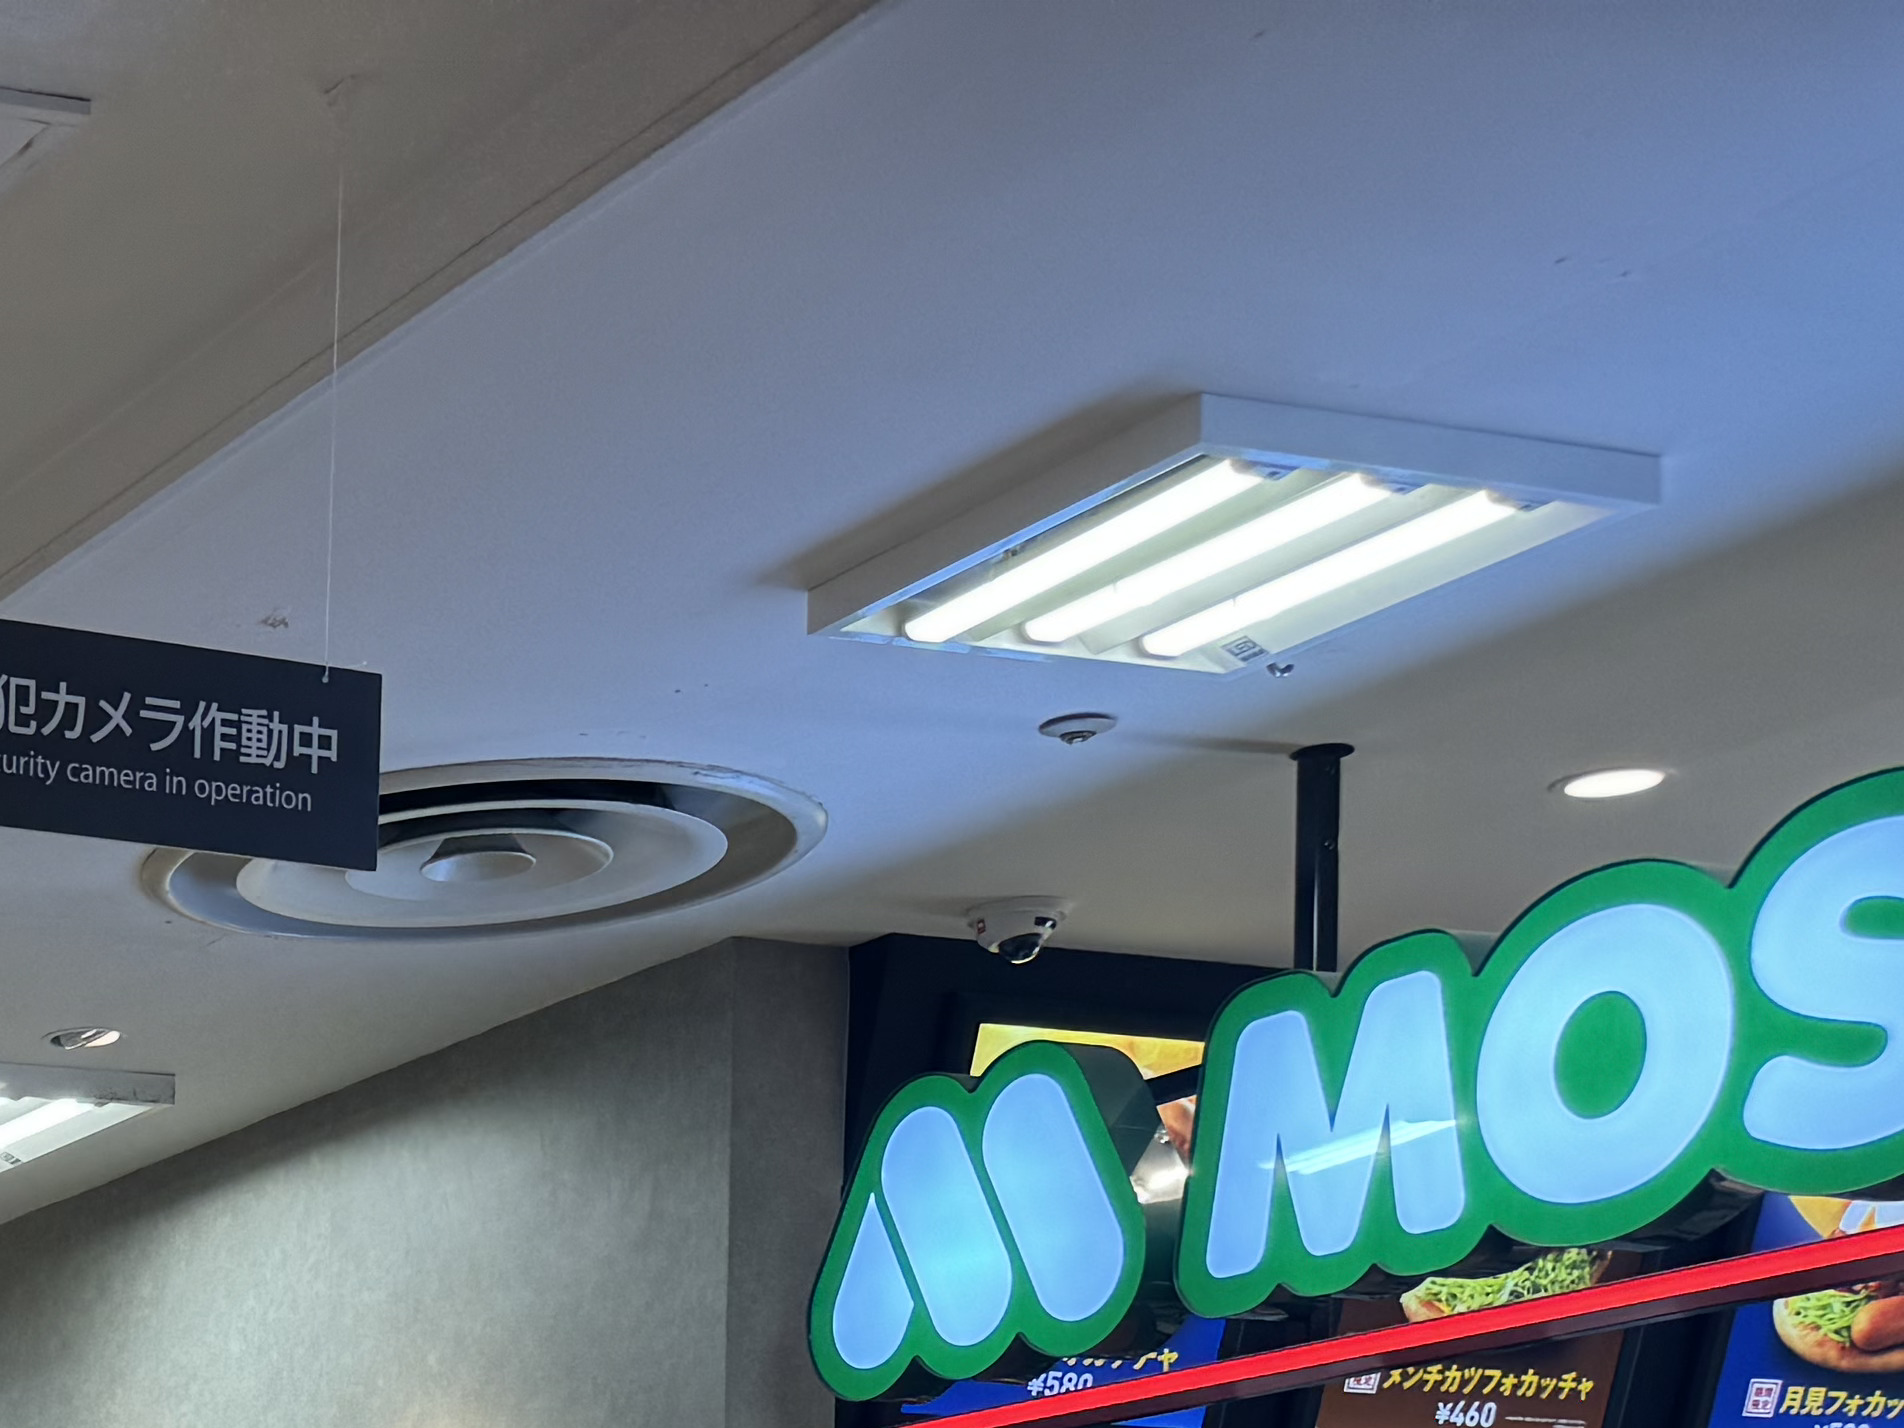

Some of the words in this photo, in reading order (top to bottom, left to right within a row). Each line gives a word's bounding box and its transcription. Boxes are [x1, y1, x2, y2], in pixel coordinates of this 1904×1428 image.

[66, 760, 157, 792] camera
[165, 768, 186, 795] in
[194, 777, 312, 813] operation
[1382, 1364, 1594, 1401] メンチカツフォカッチャ
[1435, 1401, 1497, 1428] ¥460
